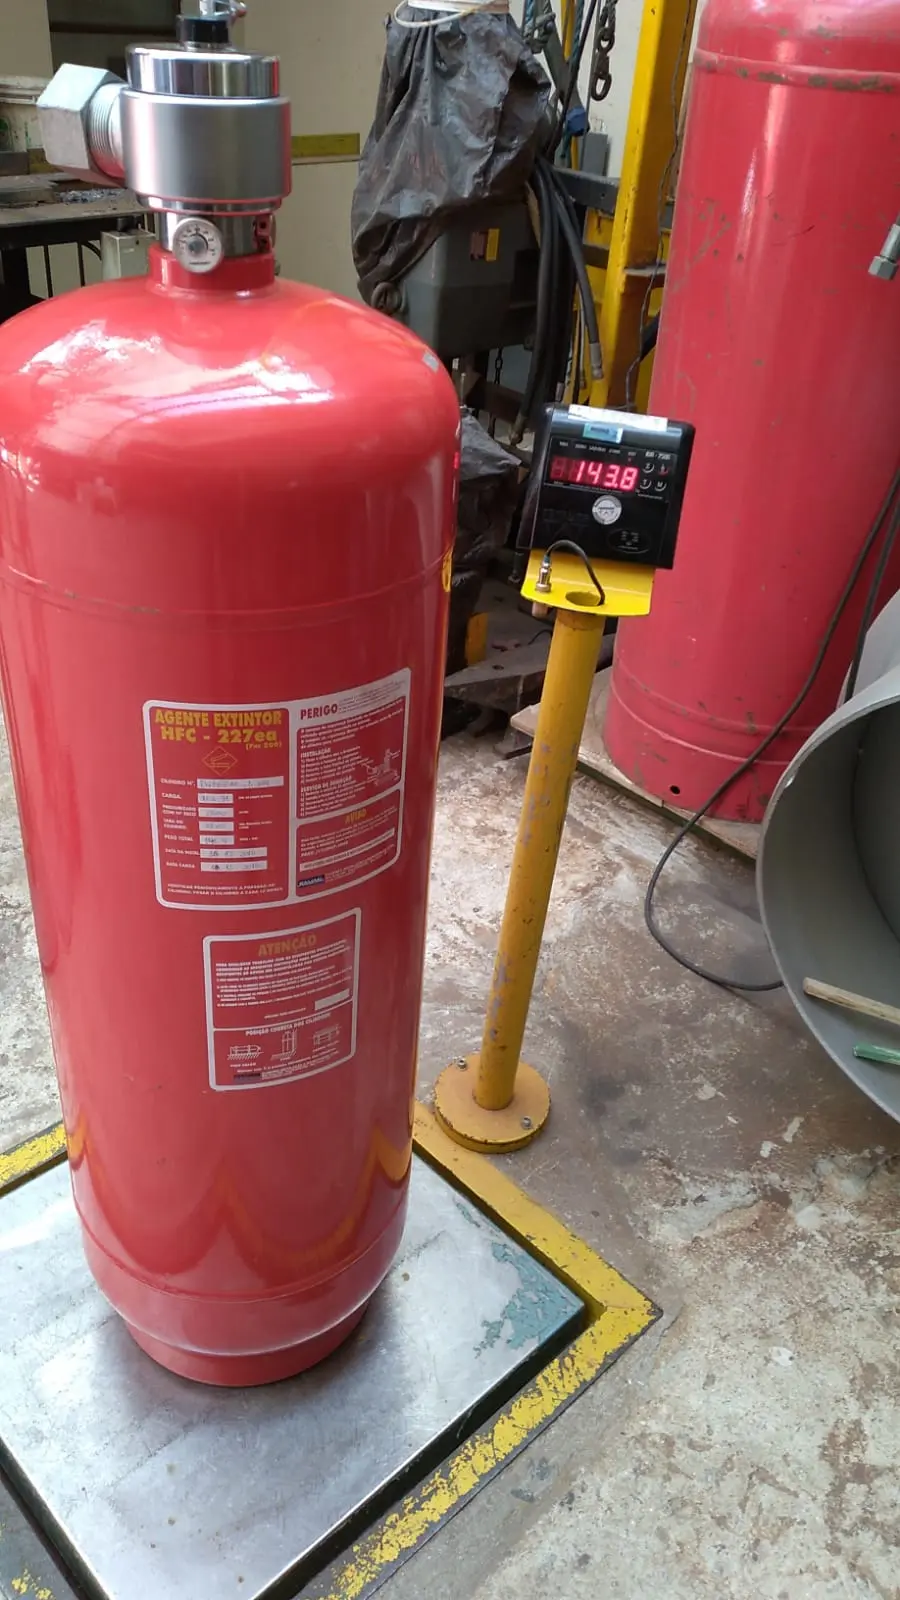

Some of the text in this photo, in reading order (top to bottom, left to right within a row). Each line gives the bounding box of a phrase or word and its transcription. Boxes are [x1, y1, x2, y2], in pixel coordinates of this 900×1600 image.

[575, 459, 639, 492] 143.8
[155, 709, 282, 728] AGENTE EXTINTOR
[300, 703, 339, 721] PERIGO
[161, 726, 197, 743] HFC
[217, 728, 277, 743] 227ea
[344, 808, 367, 824] AVISO
[258, 934, 317, 957] ATENÇÃO
